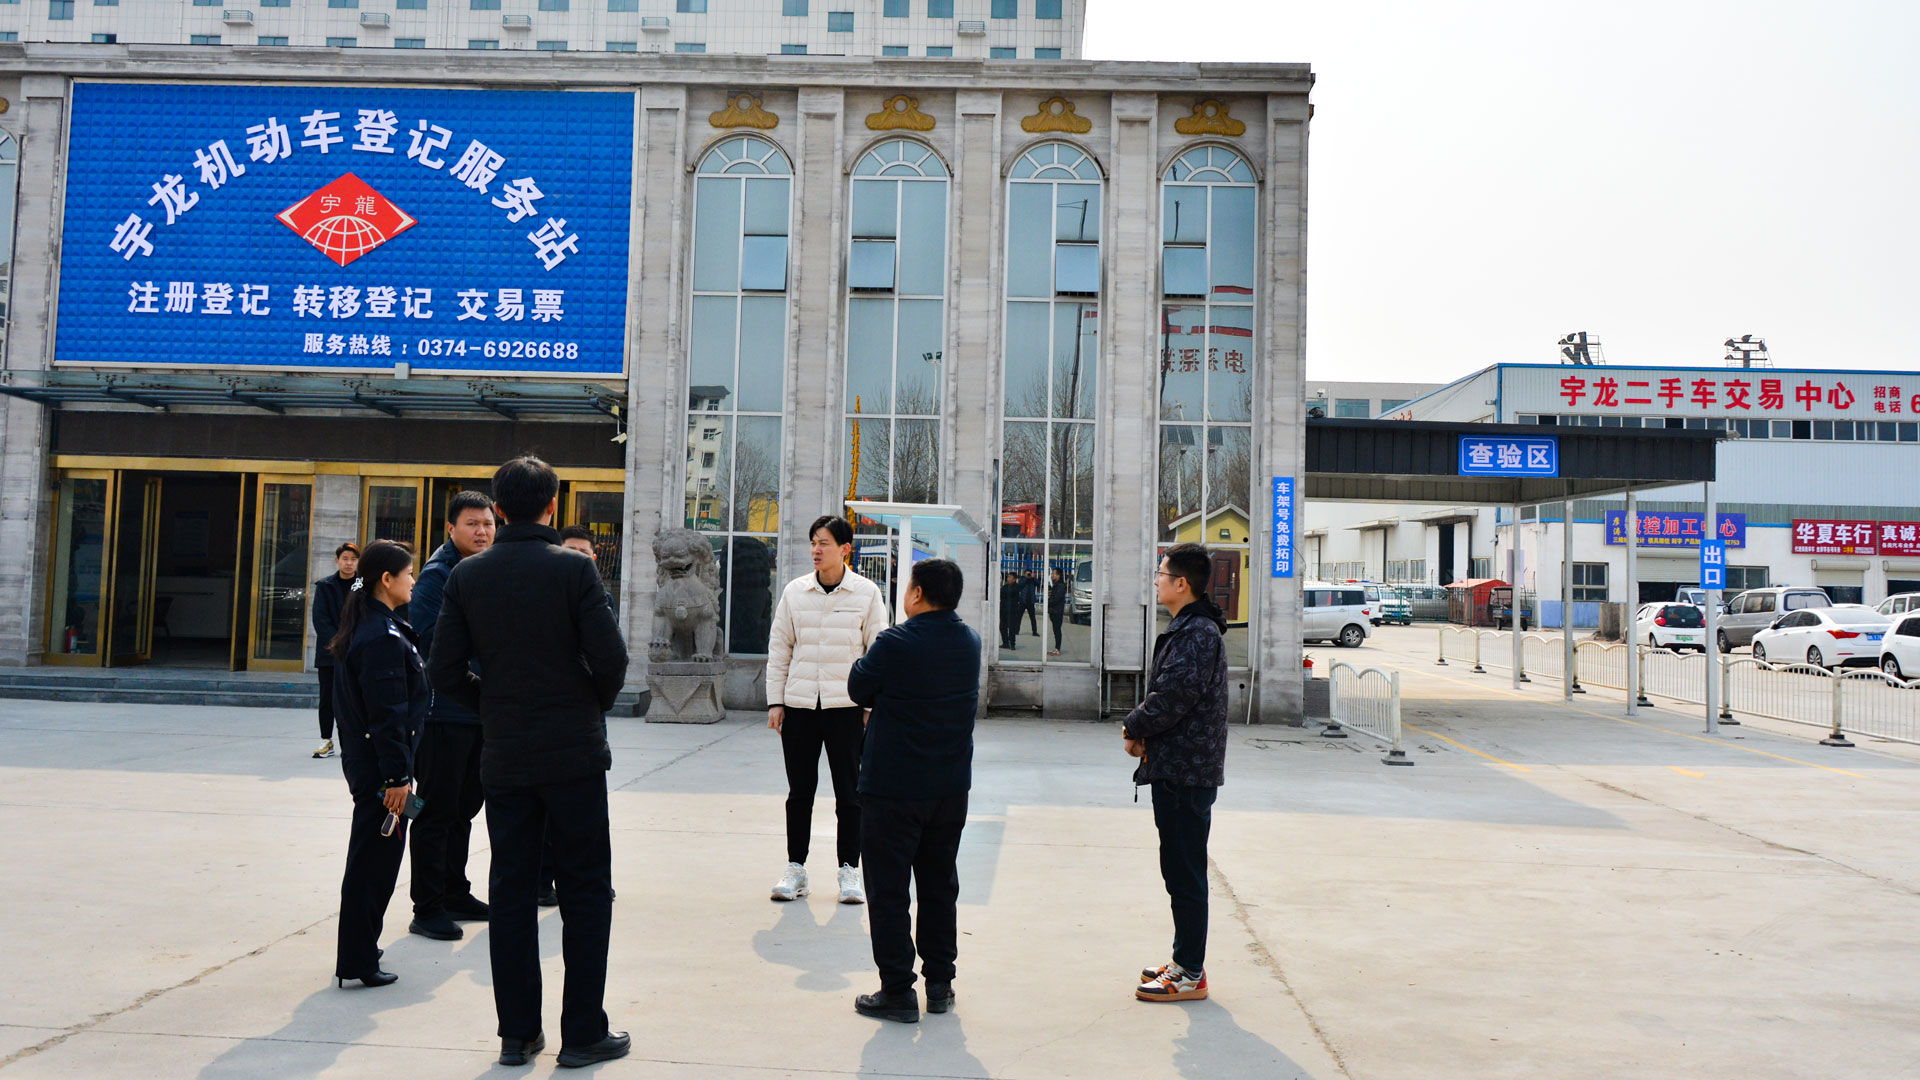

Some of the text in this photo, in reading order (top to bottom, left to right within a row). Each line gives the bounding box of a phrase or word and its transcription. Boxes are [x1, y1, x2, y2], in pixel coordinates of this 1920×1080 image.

[109, 109, 581, 272] 宇龙机动车登记服务站
[319, 194, 379, 216] 宇龍
[127, 282, 566, 323] 注册登记 转移登记 交易票
[1560, 375, 1856, 411] 宇龙二手车交易中心
[1873, 385, 1901, 399] 招商
[1874, 400, 1902, 414] 电话
[1468, 443, 1551, 469] 查验区
[1276, 481, 1291, 573] 车架号免费拓印
[1796, 522, 1873, 545] 华夏车行
[1881, 525, 1920, 542] 真诚
[1704, 545, 1722, 586] 出口
